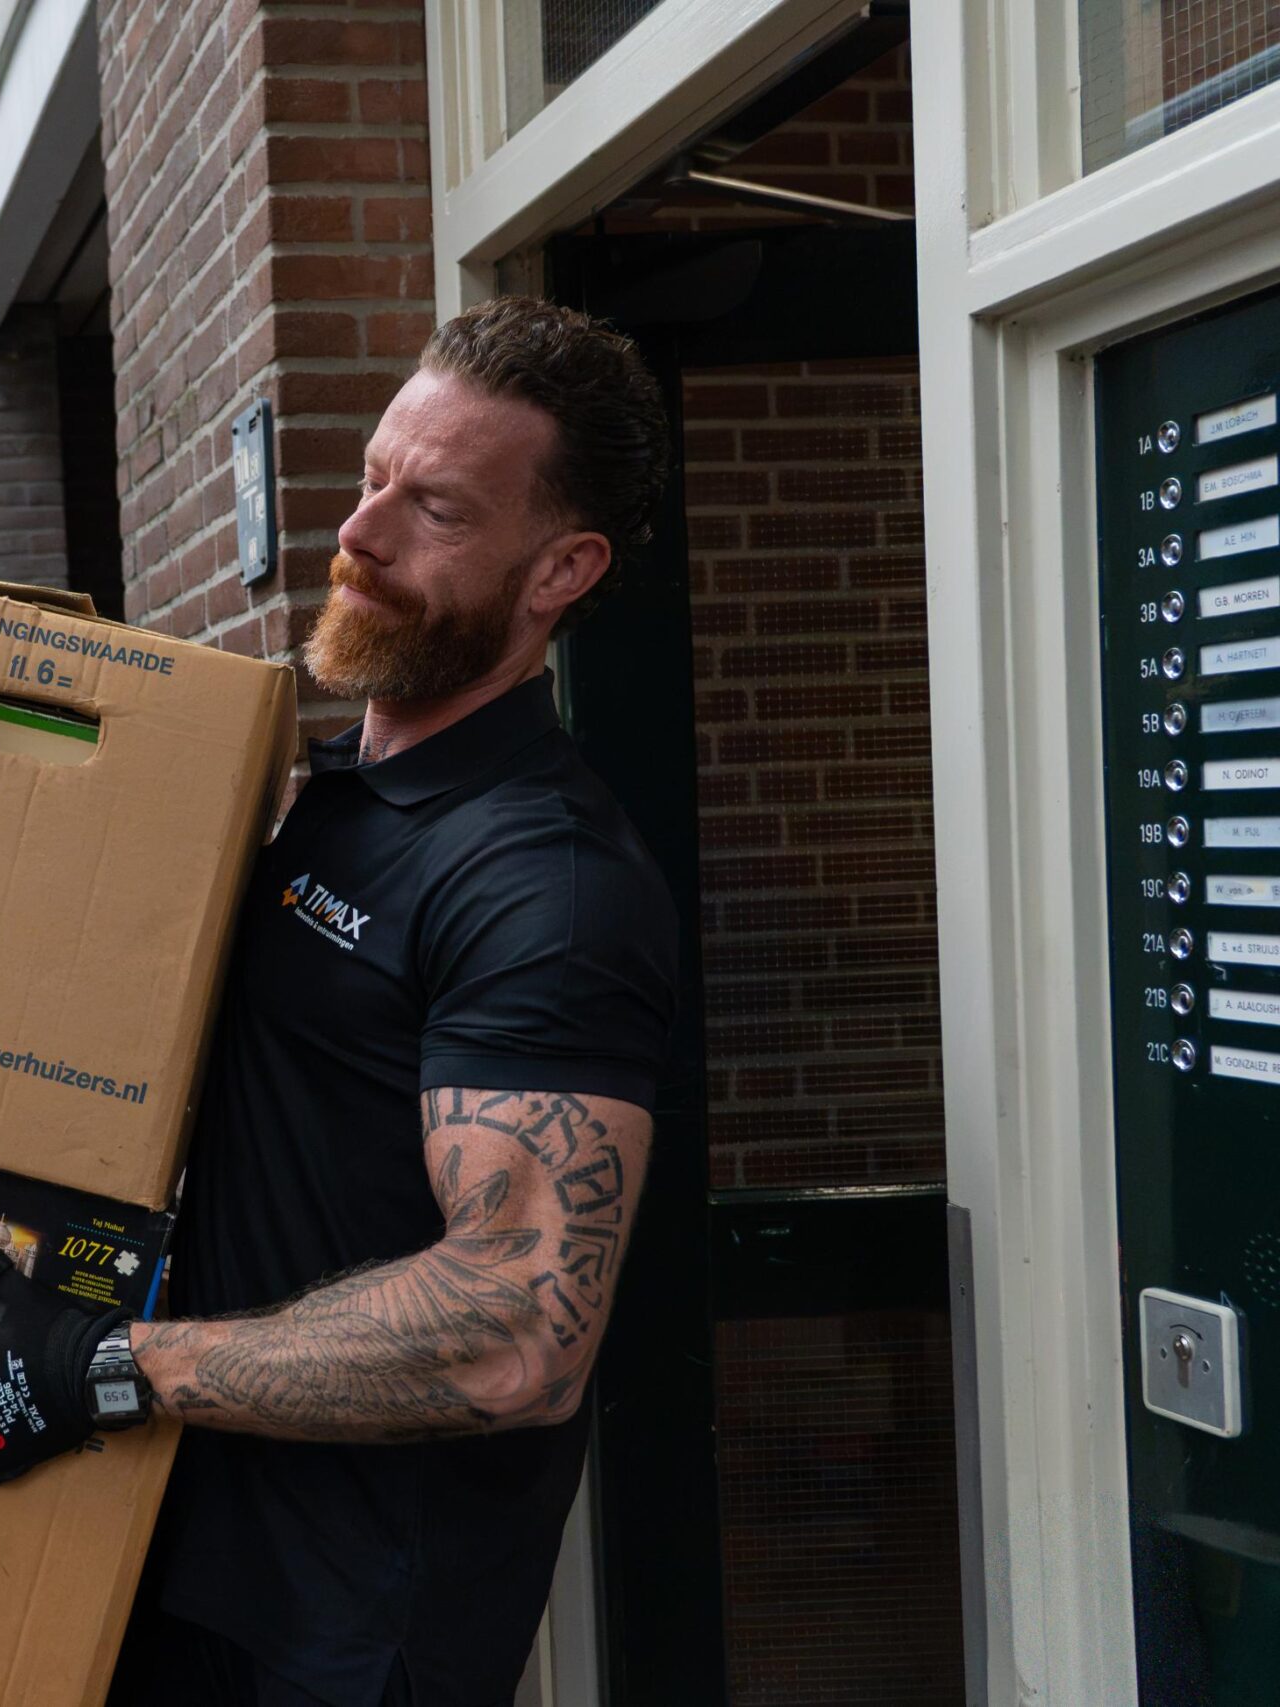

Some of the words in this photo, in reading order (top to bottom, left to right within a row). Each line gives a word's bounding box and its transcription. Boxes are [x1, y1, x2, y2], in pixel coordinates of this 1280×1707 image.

[1138, 435, 1152, 455] 1A
[1140, 491, 1155, 511] 1B
[1138, 548, 1156, 568] 3A
[1233, 588, 1270, 605] MORREN
[1140, 602, 1157, 623] 3B
[1140, 659, 1158, 679] 5A
[1142, 713, 1160, 733] 5B
[1138, 768, 1161, 788] 19A
[1235, 767, 1269, 780] ODINOT
[1140, 823, 1163, 844] 19B
[1141, 879, 1164, 899] 19C
[1143, 934, 1166, 953] 21A
[1144, 988, 1167, 1009] 21B
[1146, 1042, 1169, 1063] 21C
[1225, 1057, 1268, 1073] GONZALEZ
[93, 1217, 104, 1229] Taj
[104, 1221, 125, 1233] Mahal
[58, 1236, 115, 1266] 1077
[3, 1382, 20, 1414] 14-086
[28, 1403, 47, 1431] 10/XL
